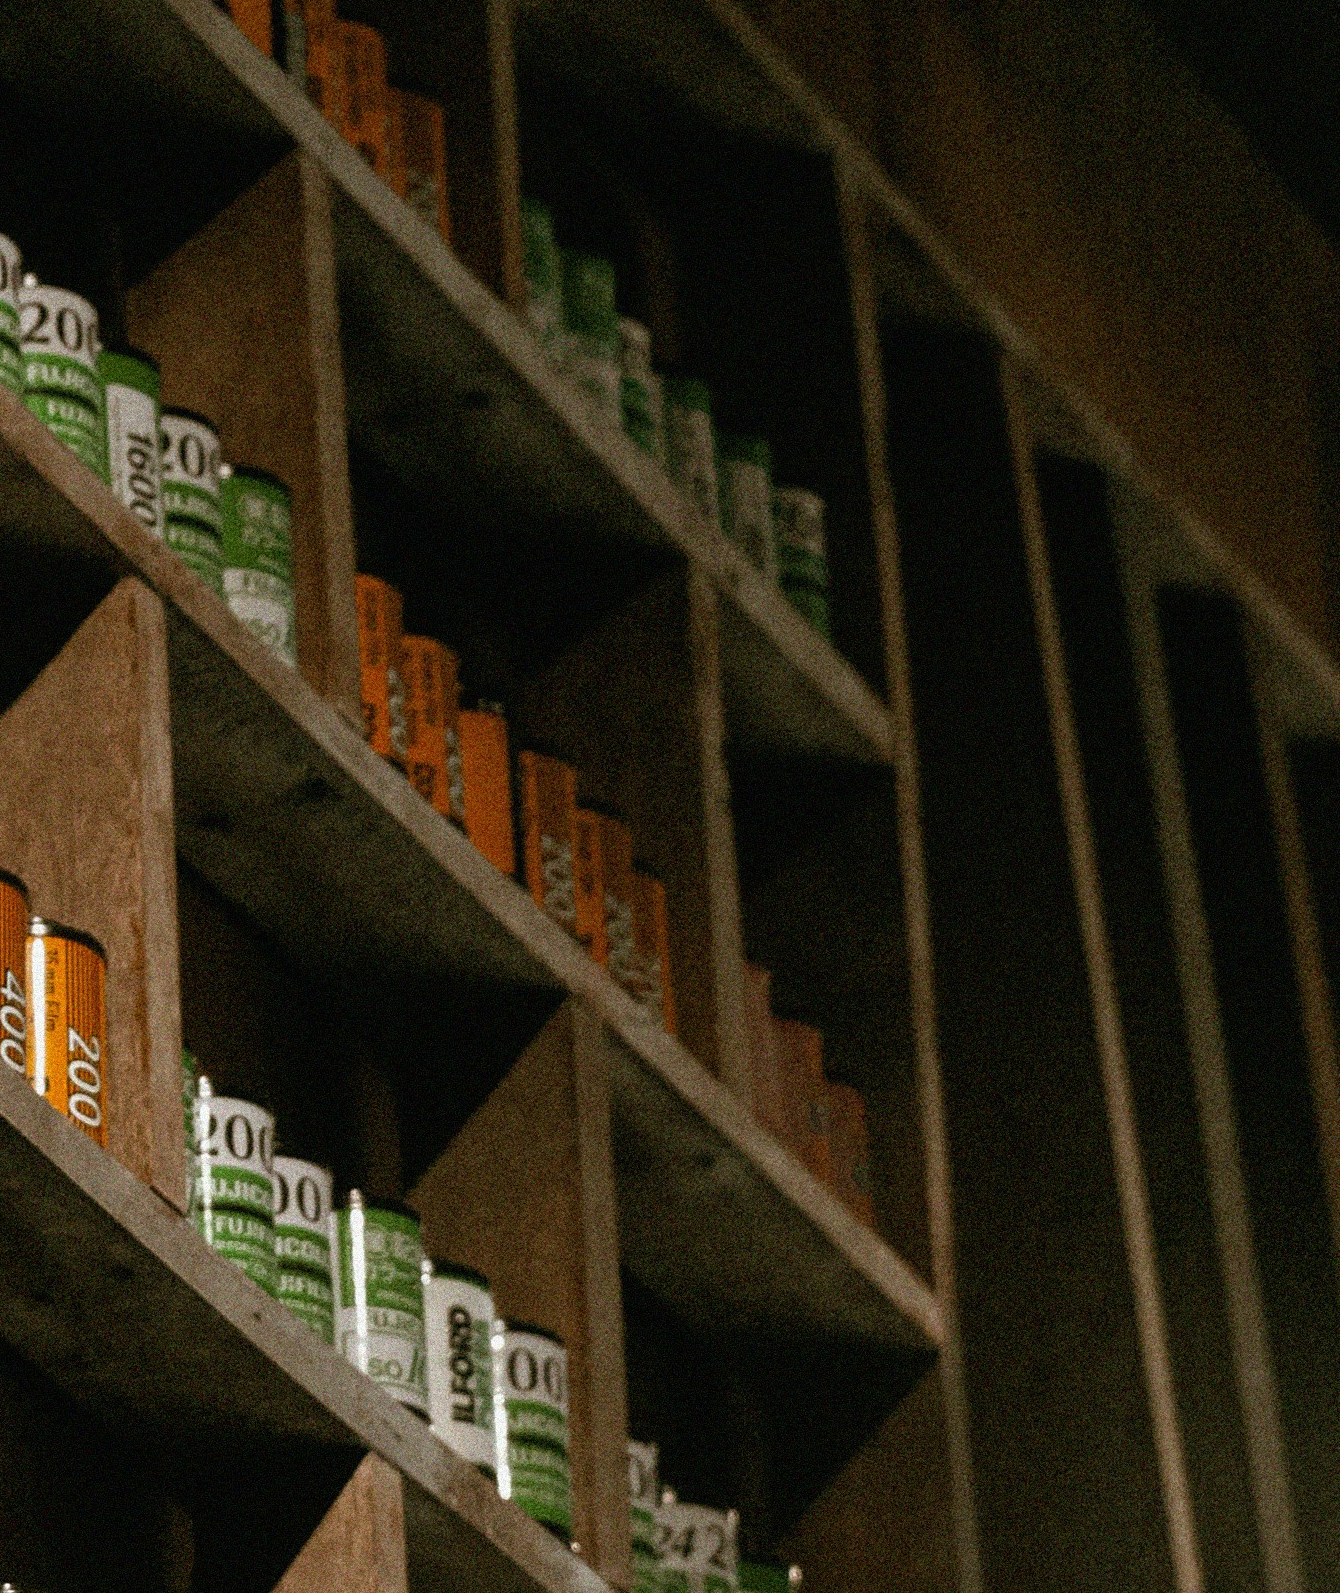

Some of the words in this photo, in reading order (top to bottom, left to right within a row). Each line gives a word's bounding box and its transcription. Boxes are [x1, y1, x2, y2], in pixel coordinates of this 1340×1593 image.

[127, 431, 158, 527] 1600
[0, 969, 26, 1073] 400
[68, 1027, 102, 1128] 200
[449, 1306, 475, 1423] ILFORD
